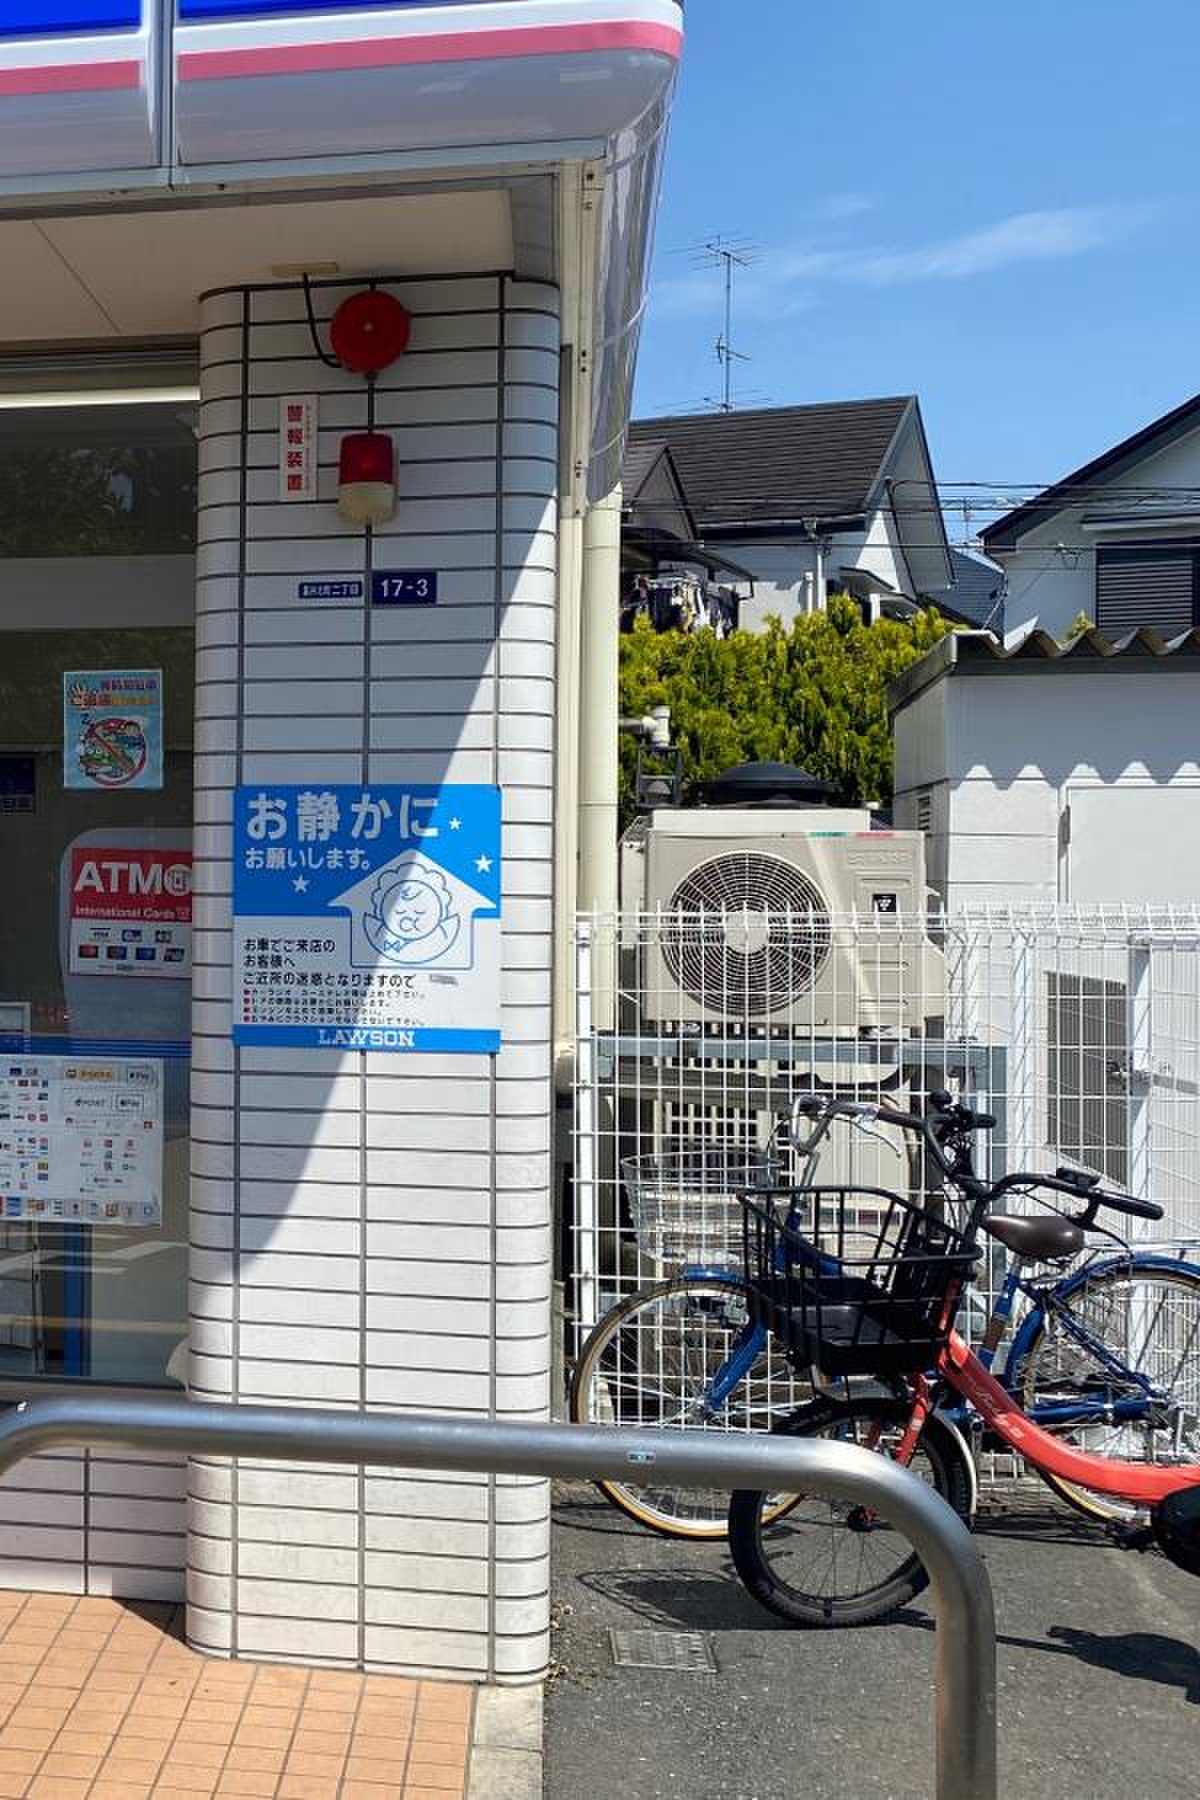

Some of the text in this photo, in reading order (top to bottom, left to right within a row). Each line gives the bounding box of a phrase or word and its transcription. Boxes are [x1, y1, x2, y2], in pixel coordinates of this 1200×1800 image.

[381, 578, 428, 597] 17-3
[246, 791, 439, 841] お静かに
[244, 847, 371, 870] お願いします。
[74, 862, 163, 895] ATM
[243, 938, 336, 953] お車でご来店の
[243, 954, 296, 968] お客様へ
[243, 972, 416, 987] ご近所の迷惑となりますので
[317, 1029, 416, 1047] LAWSON
